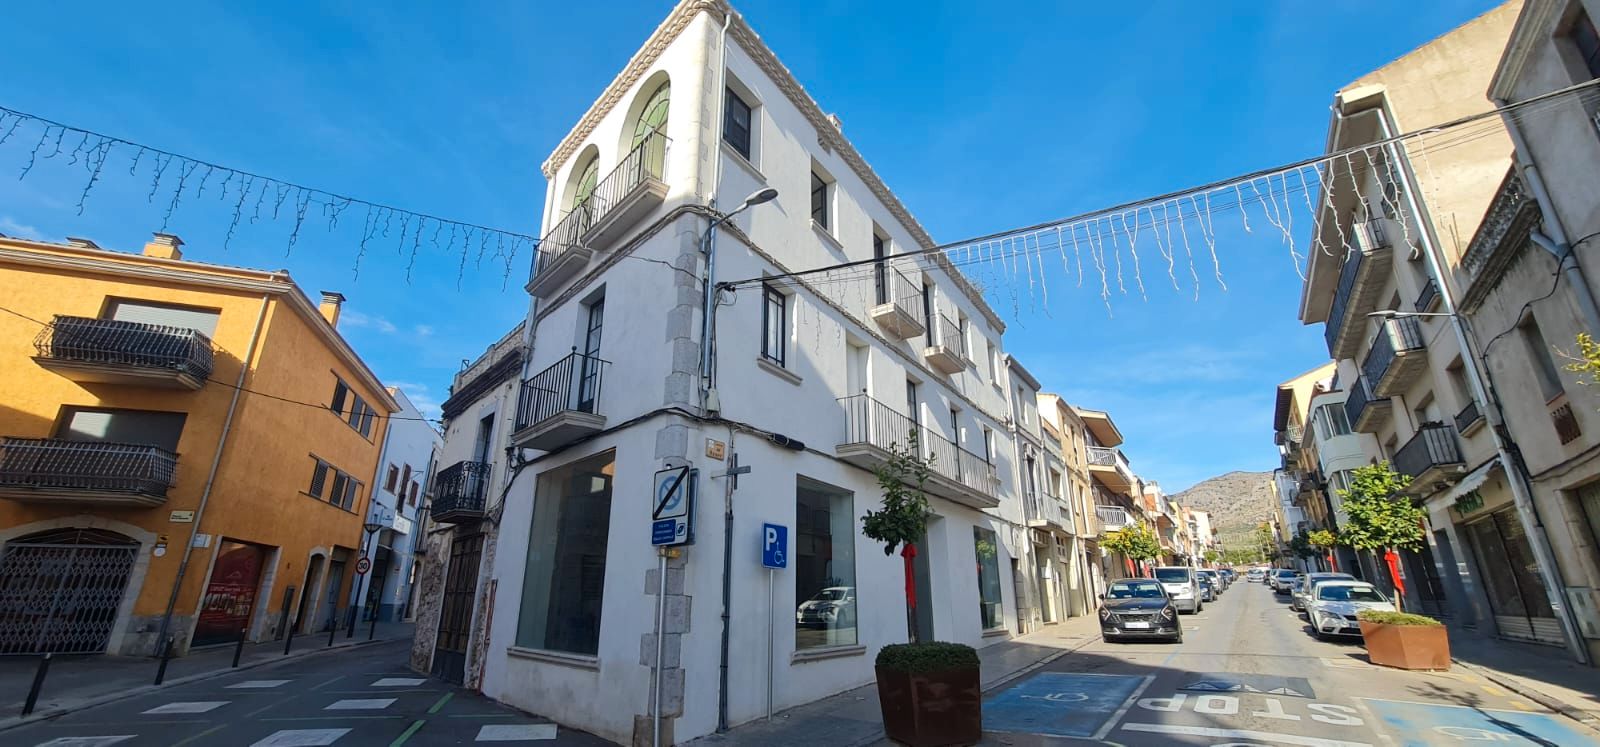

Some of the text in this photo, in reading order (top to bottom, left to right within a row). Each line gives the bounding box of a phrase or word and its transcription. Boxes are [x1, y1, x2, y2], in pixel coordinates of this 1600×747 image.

[766, 527, 777, 551] P
[358, 562, 368, 570] 30
[1137, 693, 1364, 725] STOP
